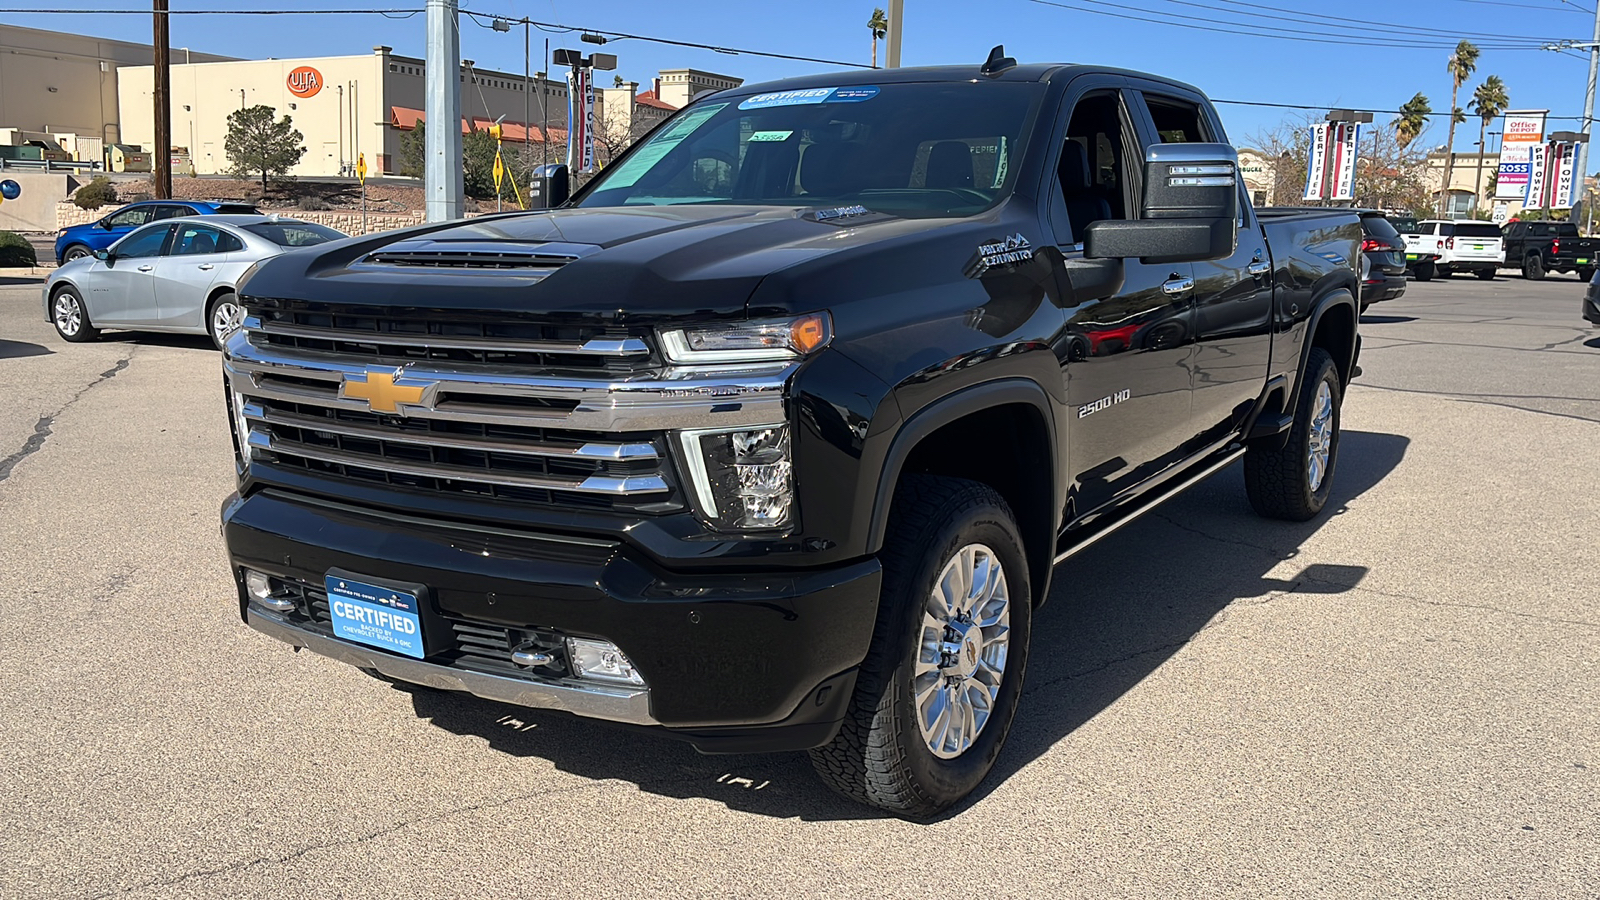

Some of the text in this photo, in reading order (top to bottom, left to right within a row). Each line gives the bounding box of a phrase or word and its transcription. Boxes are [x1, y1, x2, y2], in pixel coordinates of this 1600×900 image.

[291, 72, 318, 86] ULTA
[747, 89, 829, 103] CERTIFIED
[583, 73, 593, 167] PRE OWNED
[1310, 127, 1324, 195] CERTIFIED
[1340, 125, 1354, 195] CERTIFIED
[1499, 164, 1528, 173] ROSS
[1558, 145, 1573, 205] PRE OWNED
[1529, 147, 1543, 206] PRE OWNED
[983, 249, 1033, 266] COUNTRY
[1078, 388, 1131, 419] 2500 HD
[333, 600, 416, 635] CERTIFIED
[360, 624, 384, 635] BACKED
[342, 625, 376, 638] CHEVROLET
[376, 632, 394, 643] BUICK
[399, 639, 412, 649] GMC
